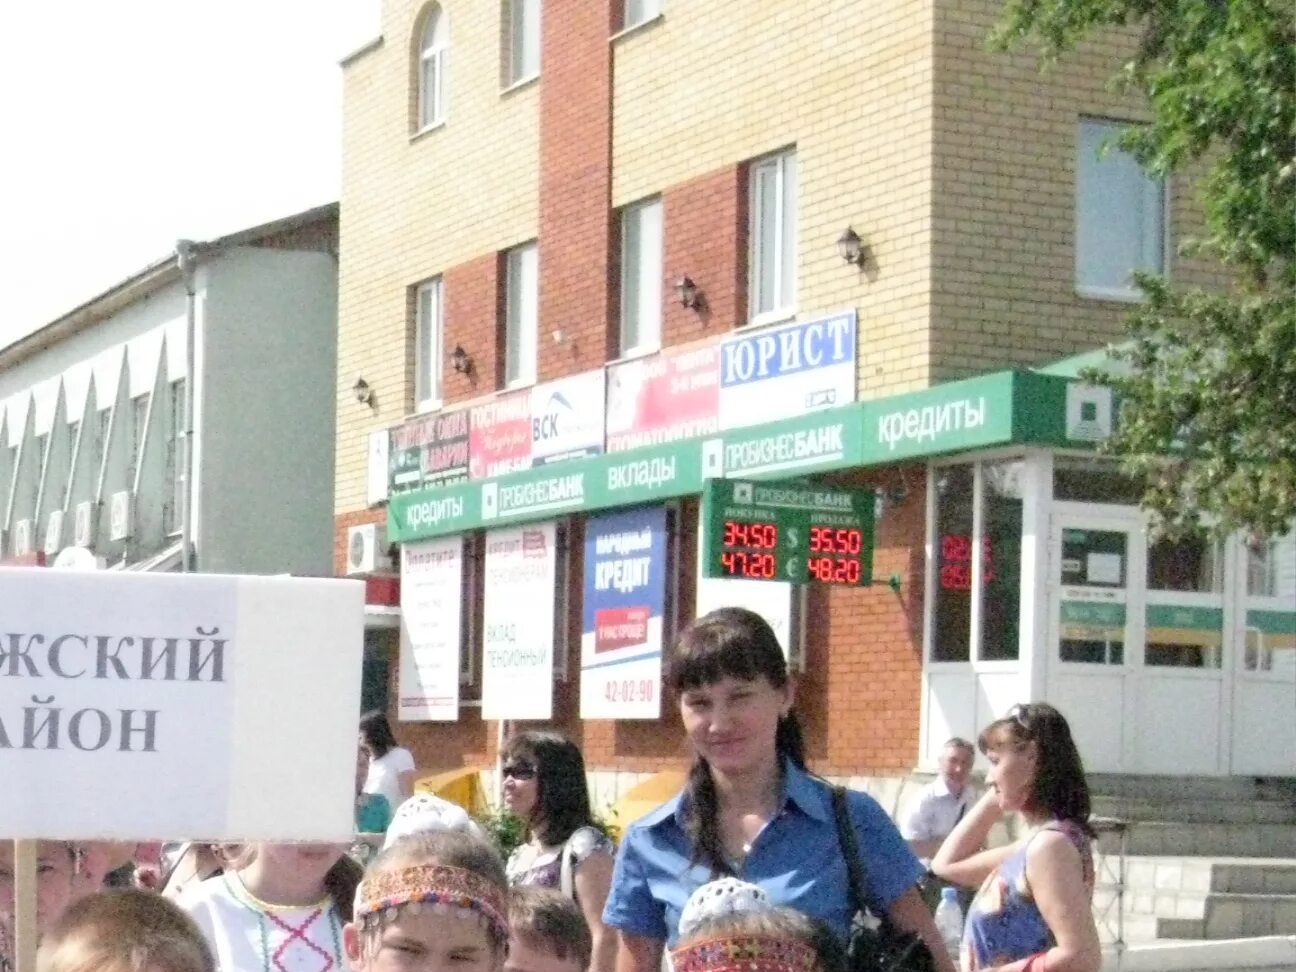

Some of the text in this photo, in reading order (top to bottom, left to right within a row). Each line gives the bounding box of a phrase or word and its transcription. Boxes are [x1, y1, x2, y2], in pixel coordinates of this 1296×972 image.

[724, 319, 849, 383] ЮРИСТ
[533, 413, 557, 441] ВСК
[878, 397, 985, 448] кредиты
[725, 424, 843, 471] ПРОБИЗНЕСБАНК
[608, 456, 675, 492] вклады
[499, 473, 584, 512] ПРОБИЗНЕСБАНК
[407, 496, 464, 530] кредиты
[724, 521, 777, 549] 34.50
[810, 526, 861, 554] 35.50
[595, 556, 651, 593] КРЕДИТ
[721, 552, 776, 578] 47.20
[808, 557, 861, 583] 48.20
[487, 623, 516, 643] ВКЛАД
[605, 679, 653, 704] 42-02-90
